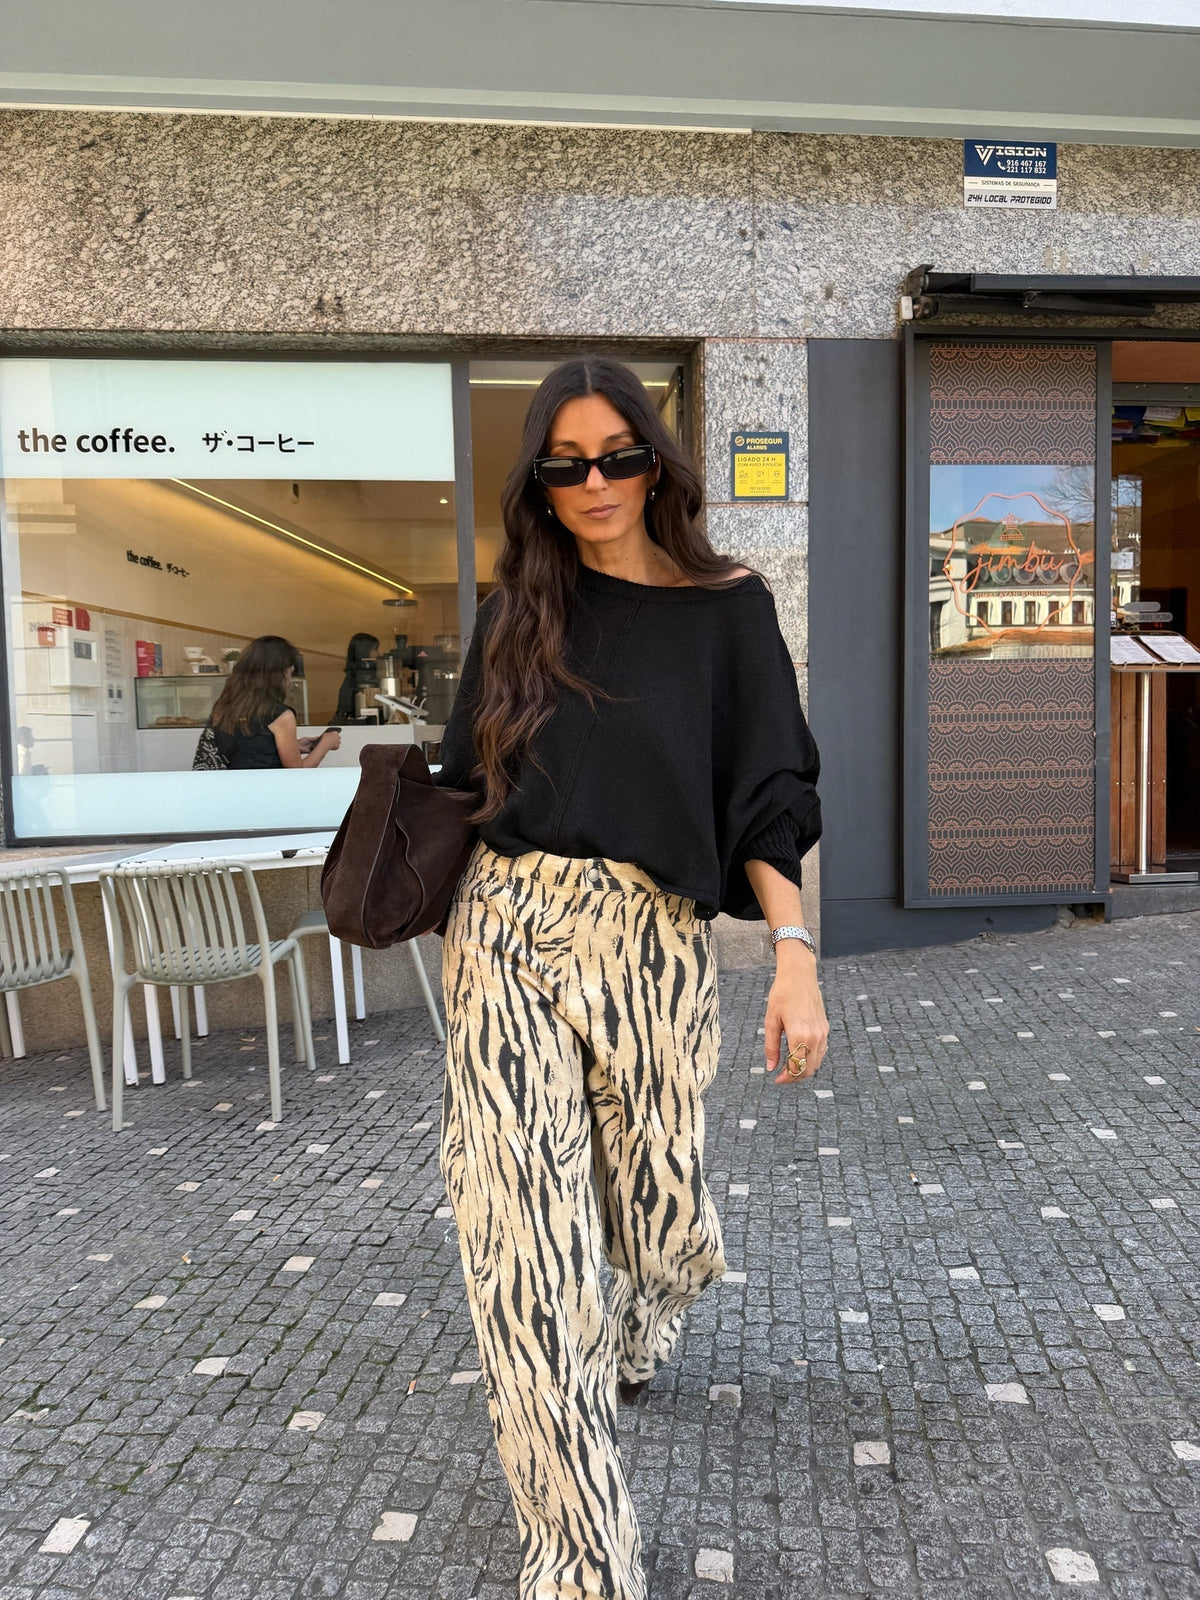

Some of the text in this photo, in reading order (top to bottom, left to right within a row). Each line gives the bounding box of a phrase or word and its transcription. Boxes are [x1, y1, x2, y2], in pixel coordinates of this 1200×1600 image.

[974, 145, 1047, 166] VIGION
[967, 194, 1052, 204] 24H LOCAL PROTEGIDO
[17, 428, 176, 454] the coffee.
[126, 550, 163, 570] the coffee.
[959, 541, 1064, 593] jimbu
